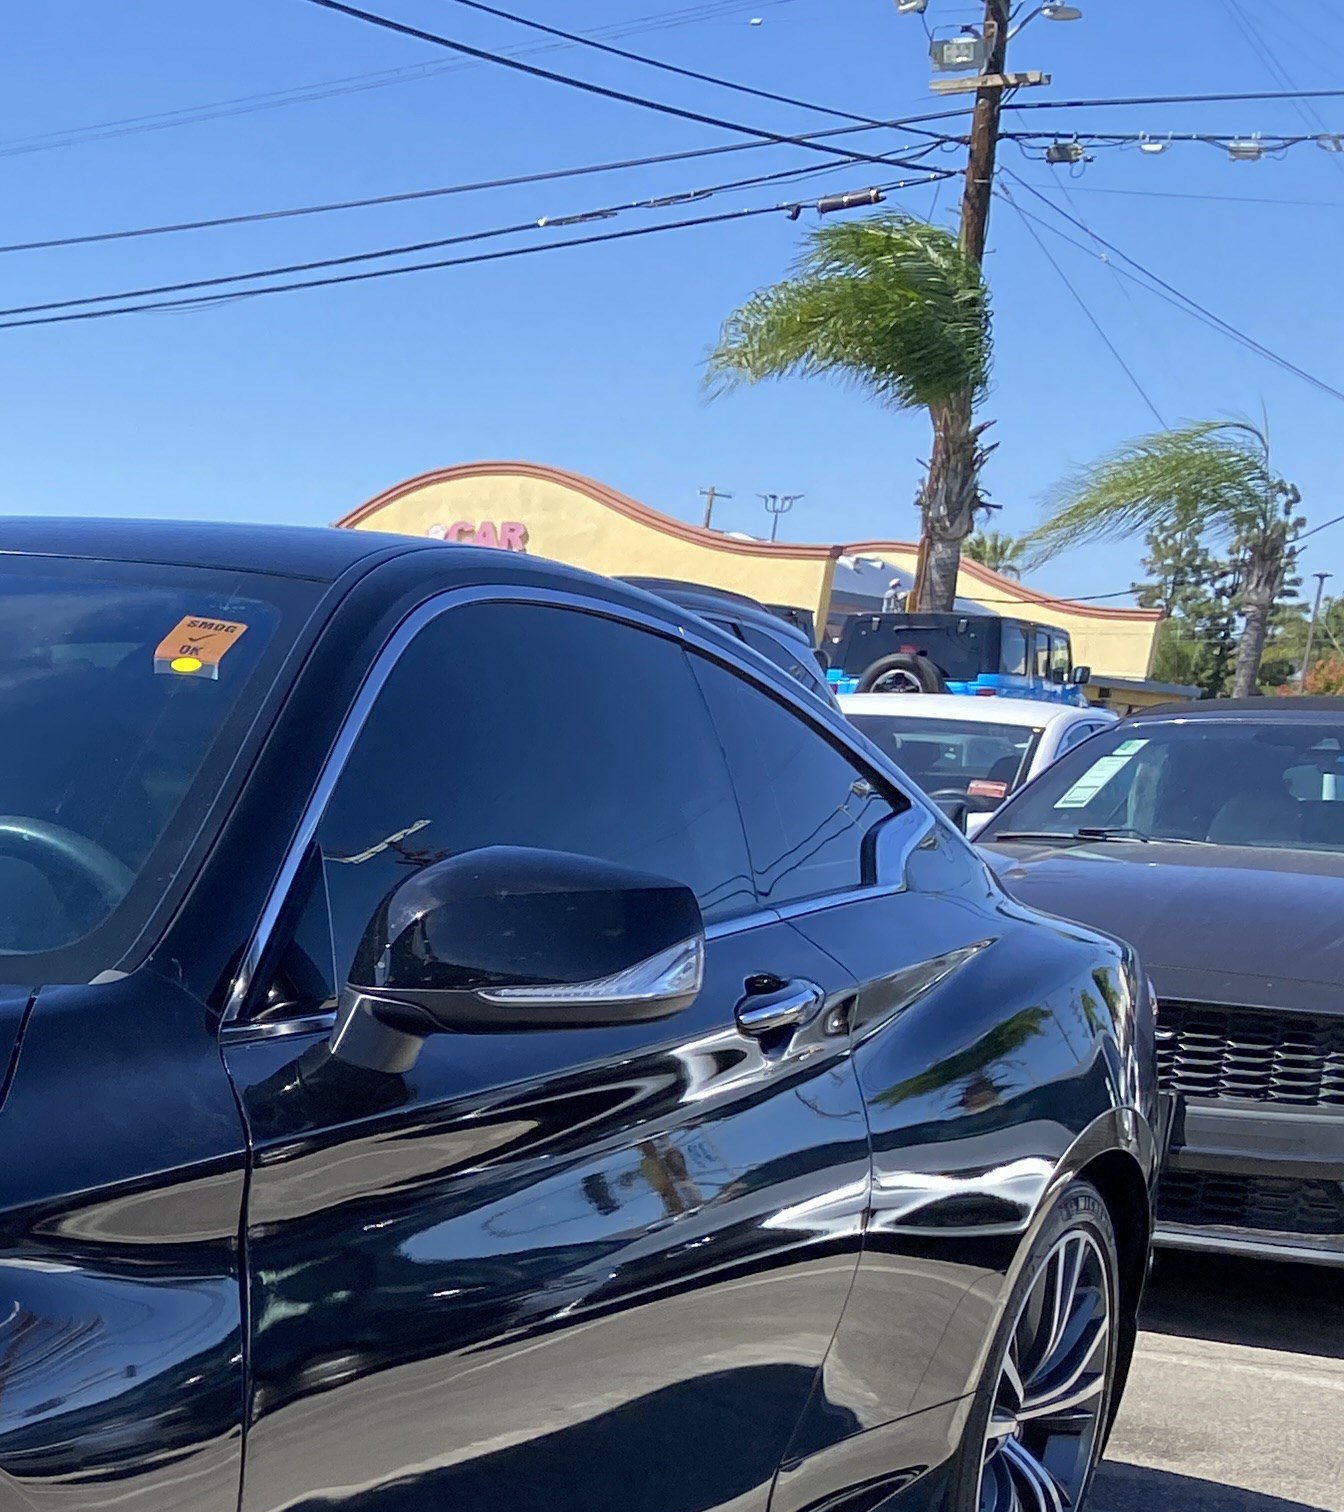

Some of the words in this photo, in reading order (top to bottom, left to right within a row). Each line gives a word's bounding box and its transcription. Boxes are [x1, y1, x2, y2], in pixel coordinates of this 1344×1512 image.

[445, 521, 528, 553] CAR
[187, 620, 237, 633] SMOG
[179, 645, 203, 656] OK
